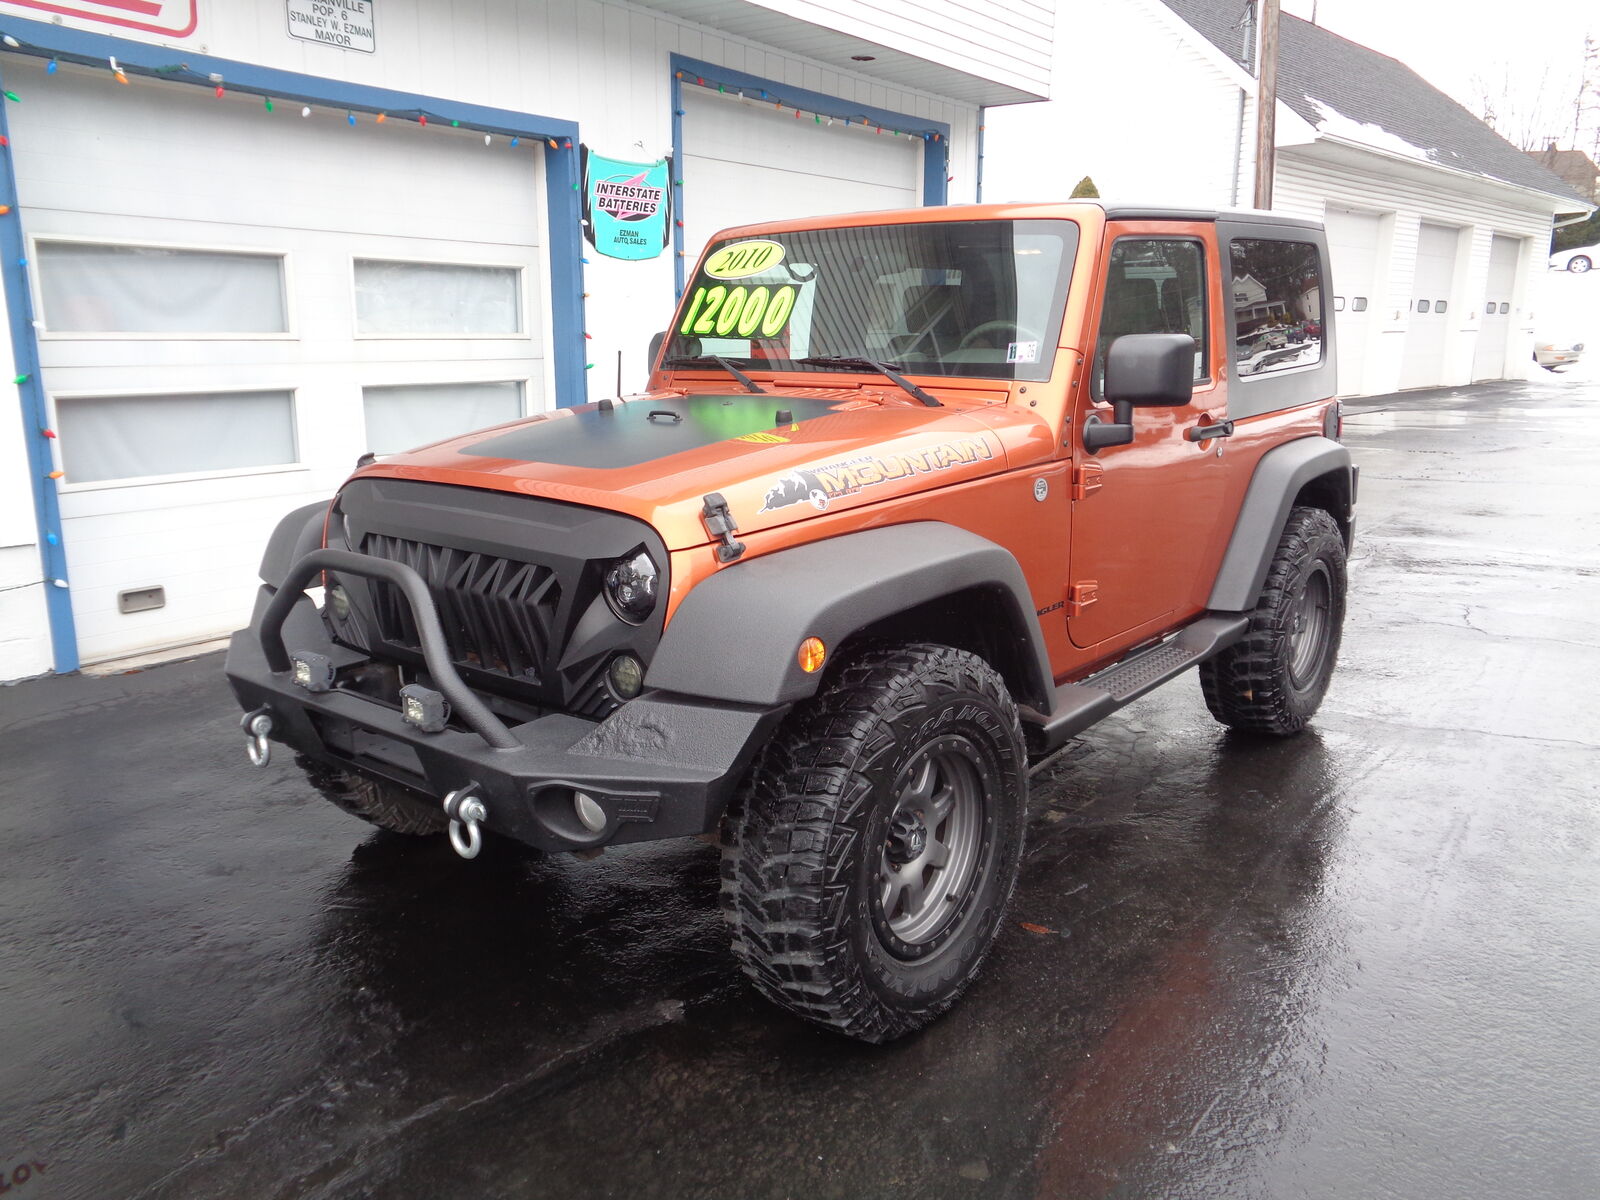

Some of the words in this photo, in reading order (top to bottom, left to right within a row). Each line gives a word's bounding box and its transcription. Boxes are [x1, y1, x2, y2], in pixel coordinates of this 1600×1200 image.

[312, 0, 365, 13] NVILLE
[312, 3, 337, 19] POP.
[341, 10, 348, 21] 6
[290, 10, 328, 28] STANLEY
[331, 20, 342, 32] W.
[344, 23, 373, 39] EZMAN
[315, 29, 352, 46] MAYOR
[596, 183, 661, 201] INTERSTATE
[598, 197, 657, 213] BATTERIES
[619, 229, 640, 238] EZMAN
[629, 238, 648, 246] SALES
[714, 245, 774, 274] 2010
[680, 285, 796, 338] 12000
[815, 435, 993, 493] MOUNTAIN
